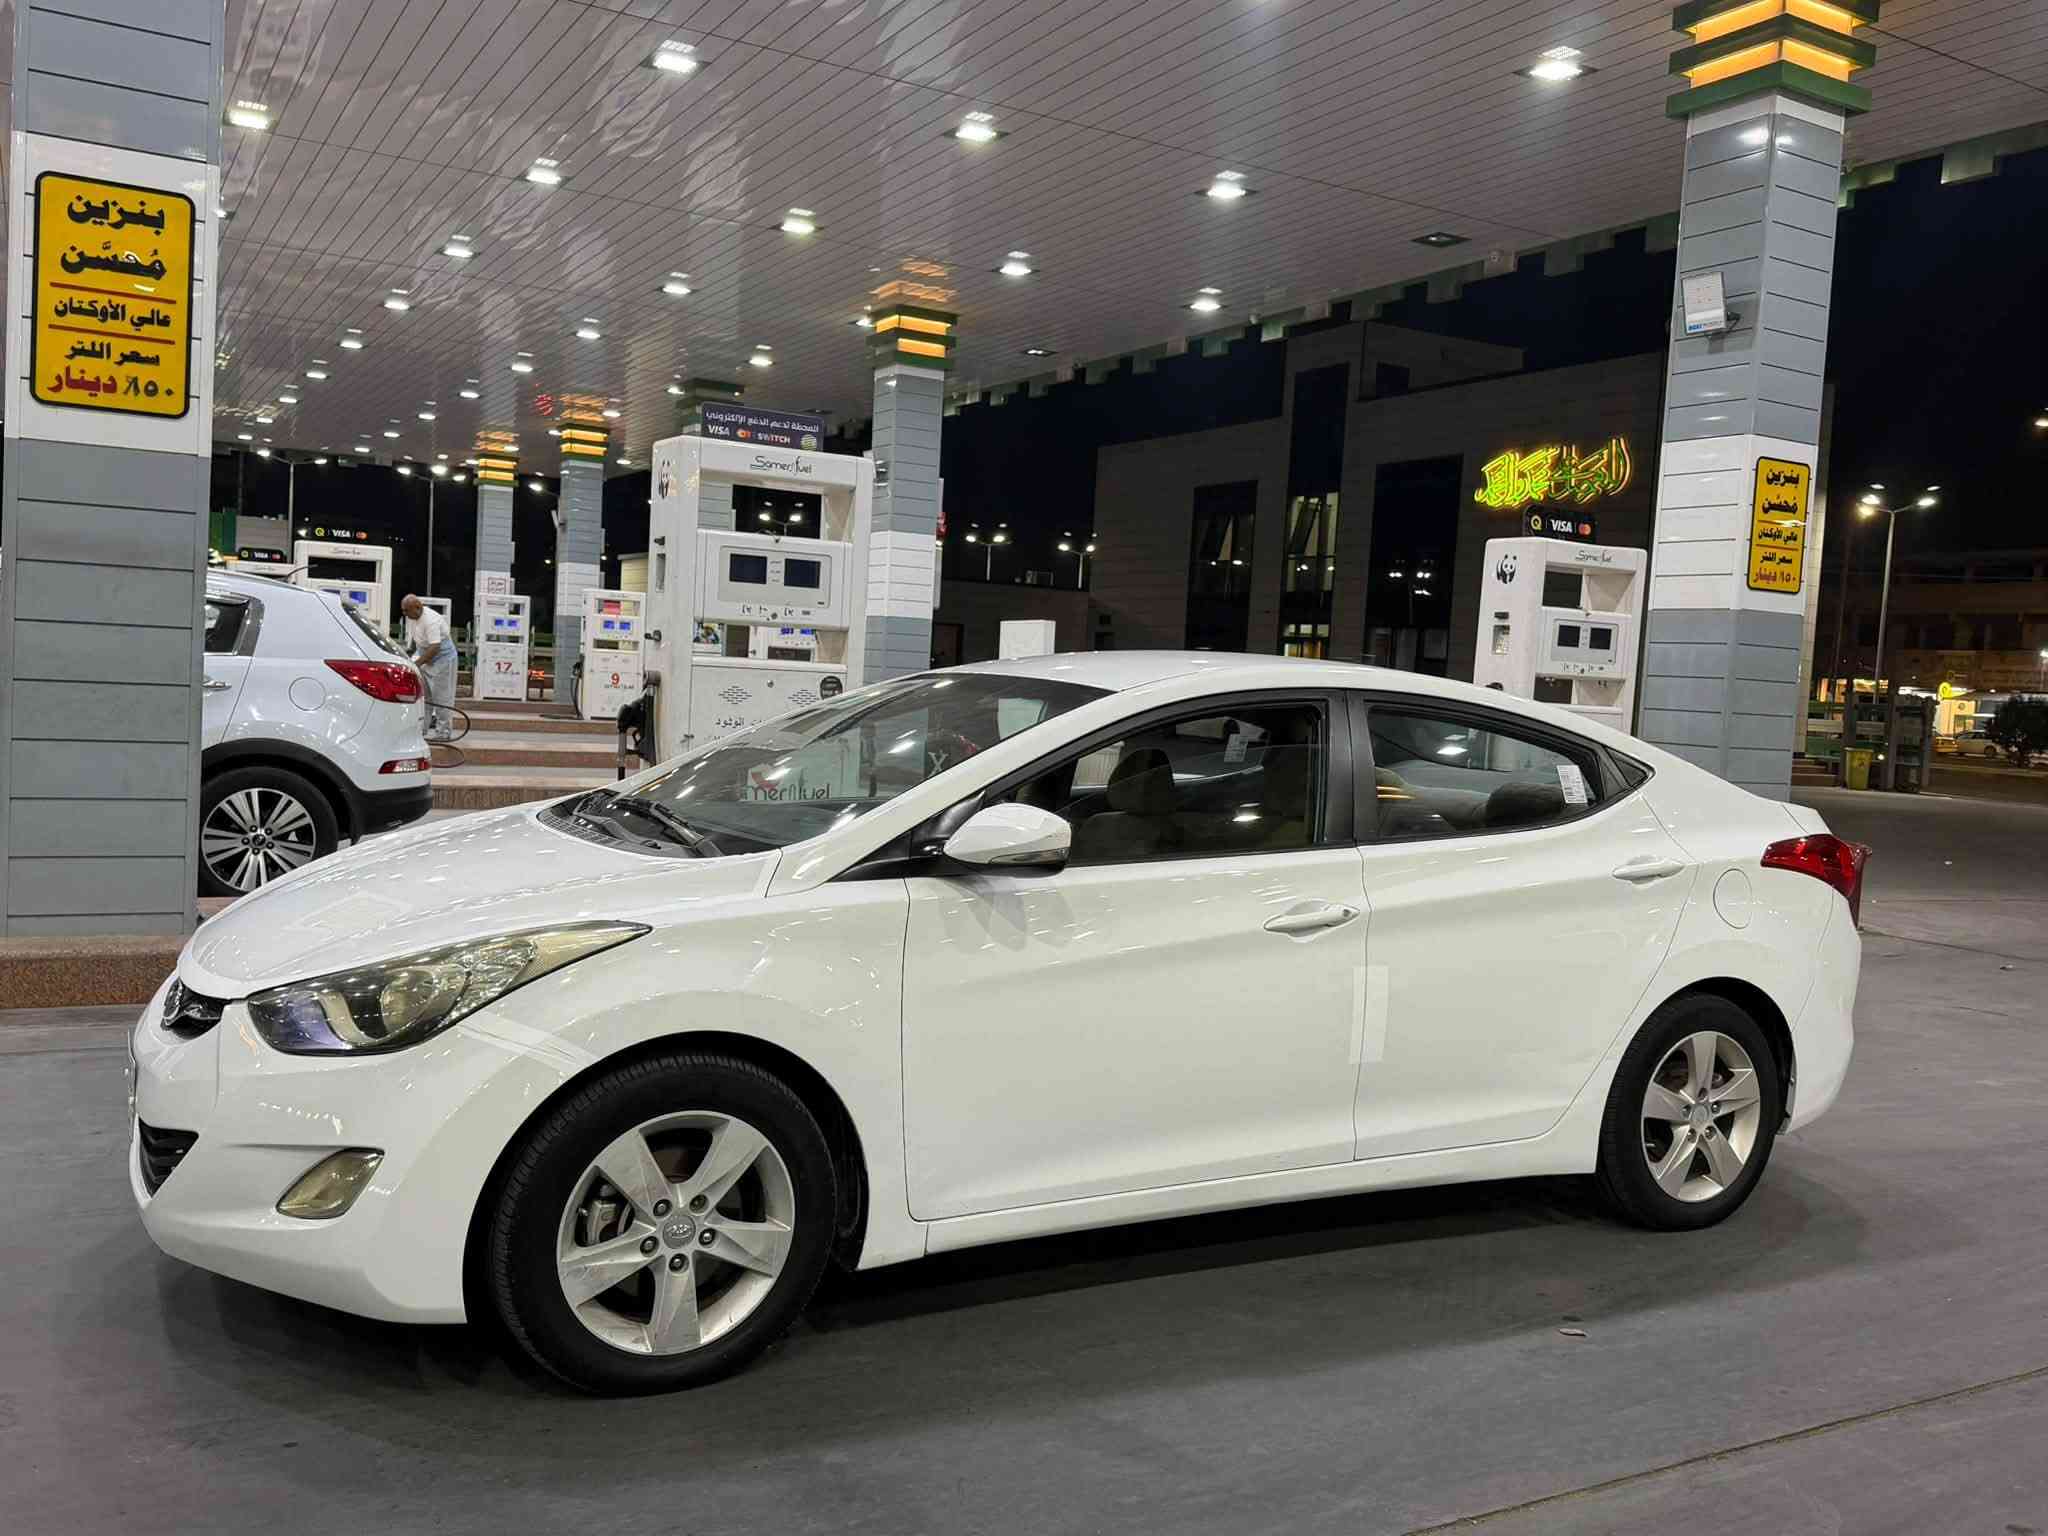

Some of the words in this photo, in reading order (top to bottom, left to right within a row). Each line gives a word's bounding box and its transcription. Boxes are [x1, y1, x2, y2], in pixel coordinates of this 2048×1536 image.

[68, 195, 165, 235] بنزين
[130, 308, 171, 332] عالي
[64, 340, 111, 360] اللتر
[114, 350, 160, 366] سعر
[47, 365, 117, 397] دينار
[707, 424, 730, 436] VISA
[757, 432, 791, 444] SWITCH
[1766, 468, 1799, 488] بنزين
[333, 528, 350, 538] VISA
[1551, 519, 1572, 533] VISA
[495, 661, 513, 673] 17
[610, 672, 620, 686] 9
